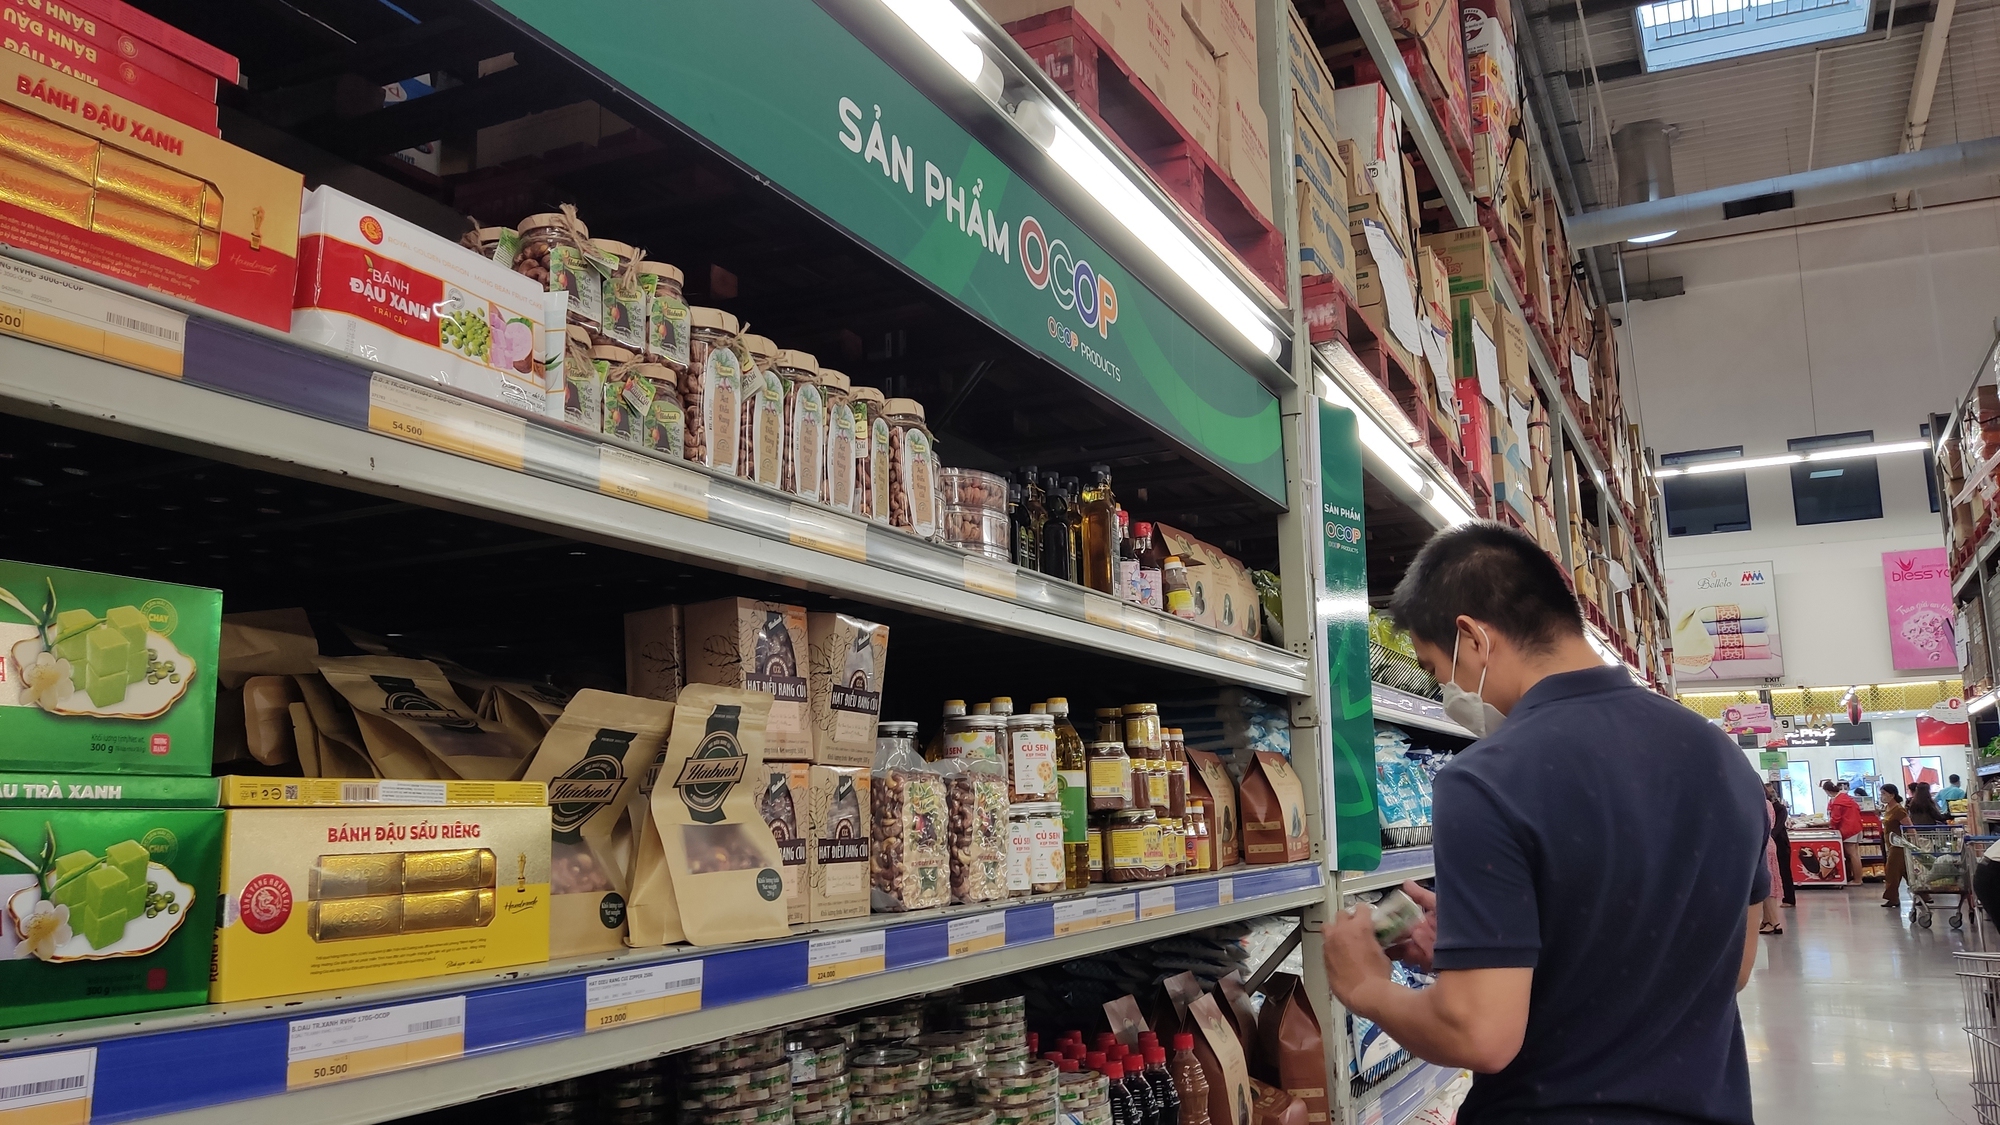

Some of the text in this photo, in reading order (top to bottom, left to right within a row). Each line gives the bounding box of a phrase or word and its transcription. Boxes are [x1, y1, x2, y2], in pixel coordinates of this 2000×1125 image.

[3, 7, 97, 64] BÁNH ĐẬU
[16, 73, 184, 156] BÁNH ĐẬU XANH
[838, 96, 1118, 340] SẢN PHẨM OCOP
[372, 266, 410, 295] BÁNH
[349, 277, 431, 323] ĐẬU XANH
[372, 305, 409, 327] TRÁI CÂY
[1047, 316, 1122, 382] OCOP PRODUCTS
[392, 421, 423, 436] 54.500
[1323, 502, 1361, 521] SẢN PHẨM
[1325, 521, 1362, 544] OCOP
[1340, 545, 1359, 554] PRODUCTS
[1892, 569, 1934, 582] bless
[148, 613, 170, 624] CHAY
[778, 682, 795, 698] RANG
[832, 691, 843, 709] HẠT
[844, 688, 857, 708] ĐIỀU
[857, 694, 871, 709] RANG
[1781, 720, 1789, 729] 9
[90, 743, 114, 754] 300 g
[950, 747, 963, 755] SEN
[1022, 742, 1049, 752] CỦ SEN
[23, 780, 122, 800] TRÀ XANH
[327, 820, 481, 845] BÁNH ĐẬU SẦU RIÊNG
[1012, 835, 1023, 846] CỦ
[1035, 830, 1061, 840] CỦ SEN
[149, 843, 170, 854] CHAY
[818, 846, 830, 863] HẠT
[831, 841, 845, 859] ĐIỀU
[844, 845, 858, 858] RANG
[817, 970, 836, 980] 224.000
[312, 1019, 339, 1030] TR.XANH
[339, 1016, 357, 1026] RVHG
[600, 1012, 627, 1026] 123.000
[313, 1063, 348, 1079] 50.500
